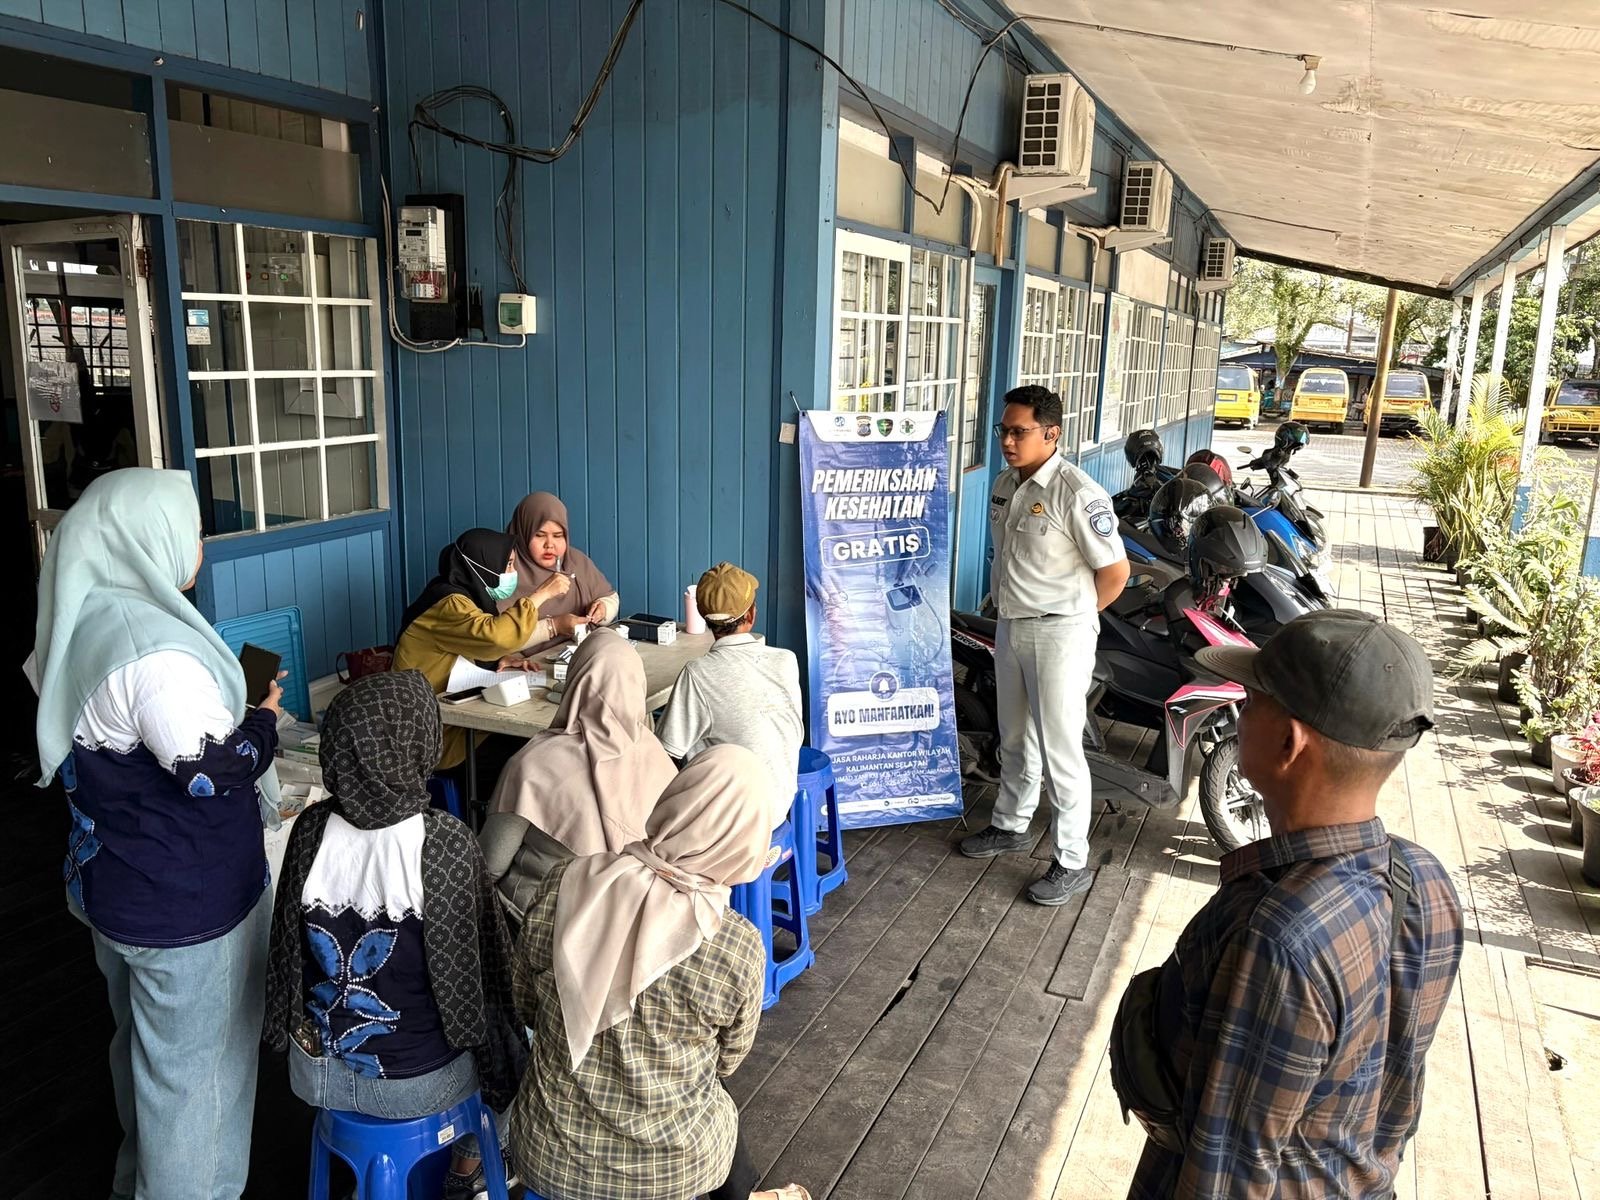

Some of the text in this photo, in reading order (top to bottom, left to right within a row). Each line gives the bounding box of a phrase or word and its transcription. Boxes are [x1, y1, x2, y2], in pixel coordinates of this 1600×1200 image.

[811, 467, 938, 494] PEMERIKSAAN
[824, 495, 926, 521] KESEHATAN
[833, 533, 920, 561] GRATIS
[834, 703, 935, 725] AYO MANFAATKAN!
[832, 747, 951, 764] JASA RAHARJA KANTOR WILAYAH
[846, 763, 894, 773] KALIMANTAN
[894, 760, 928, 769] SELATAN
